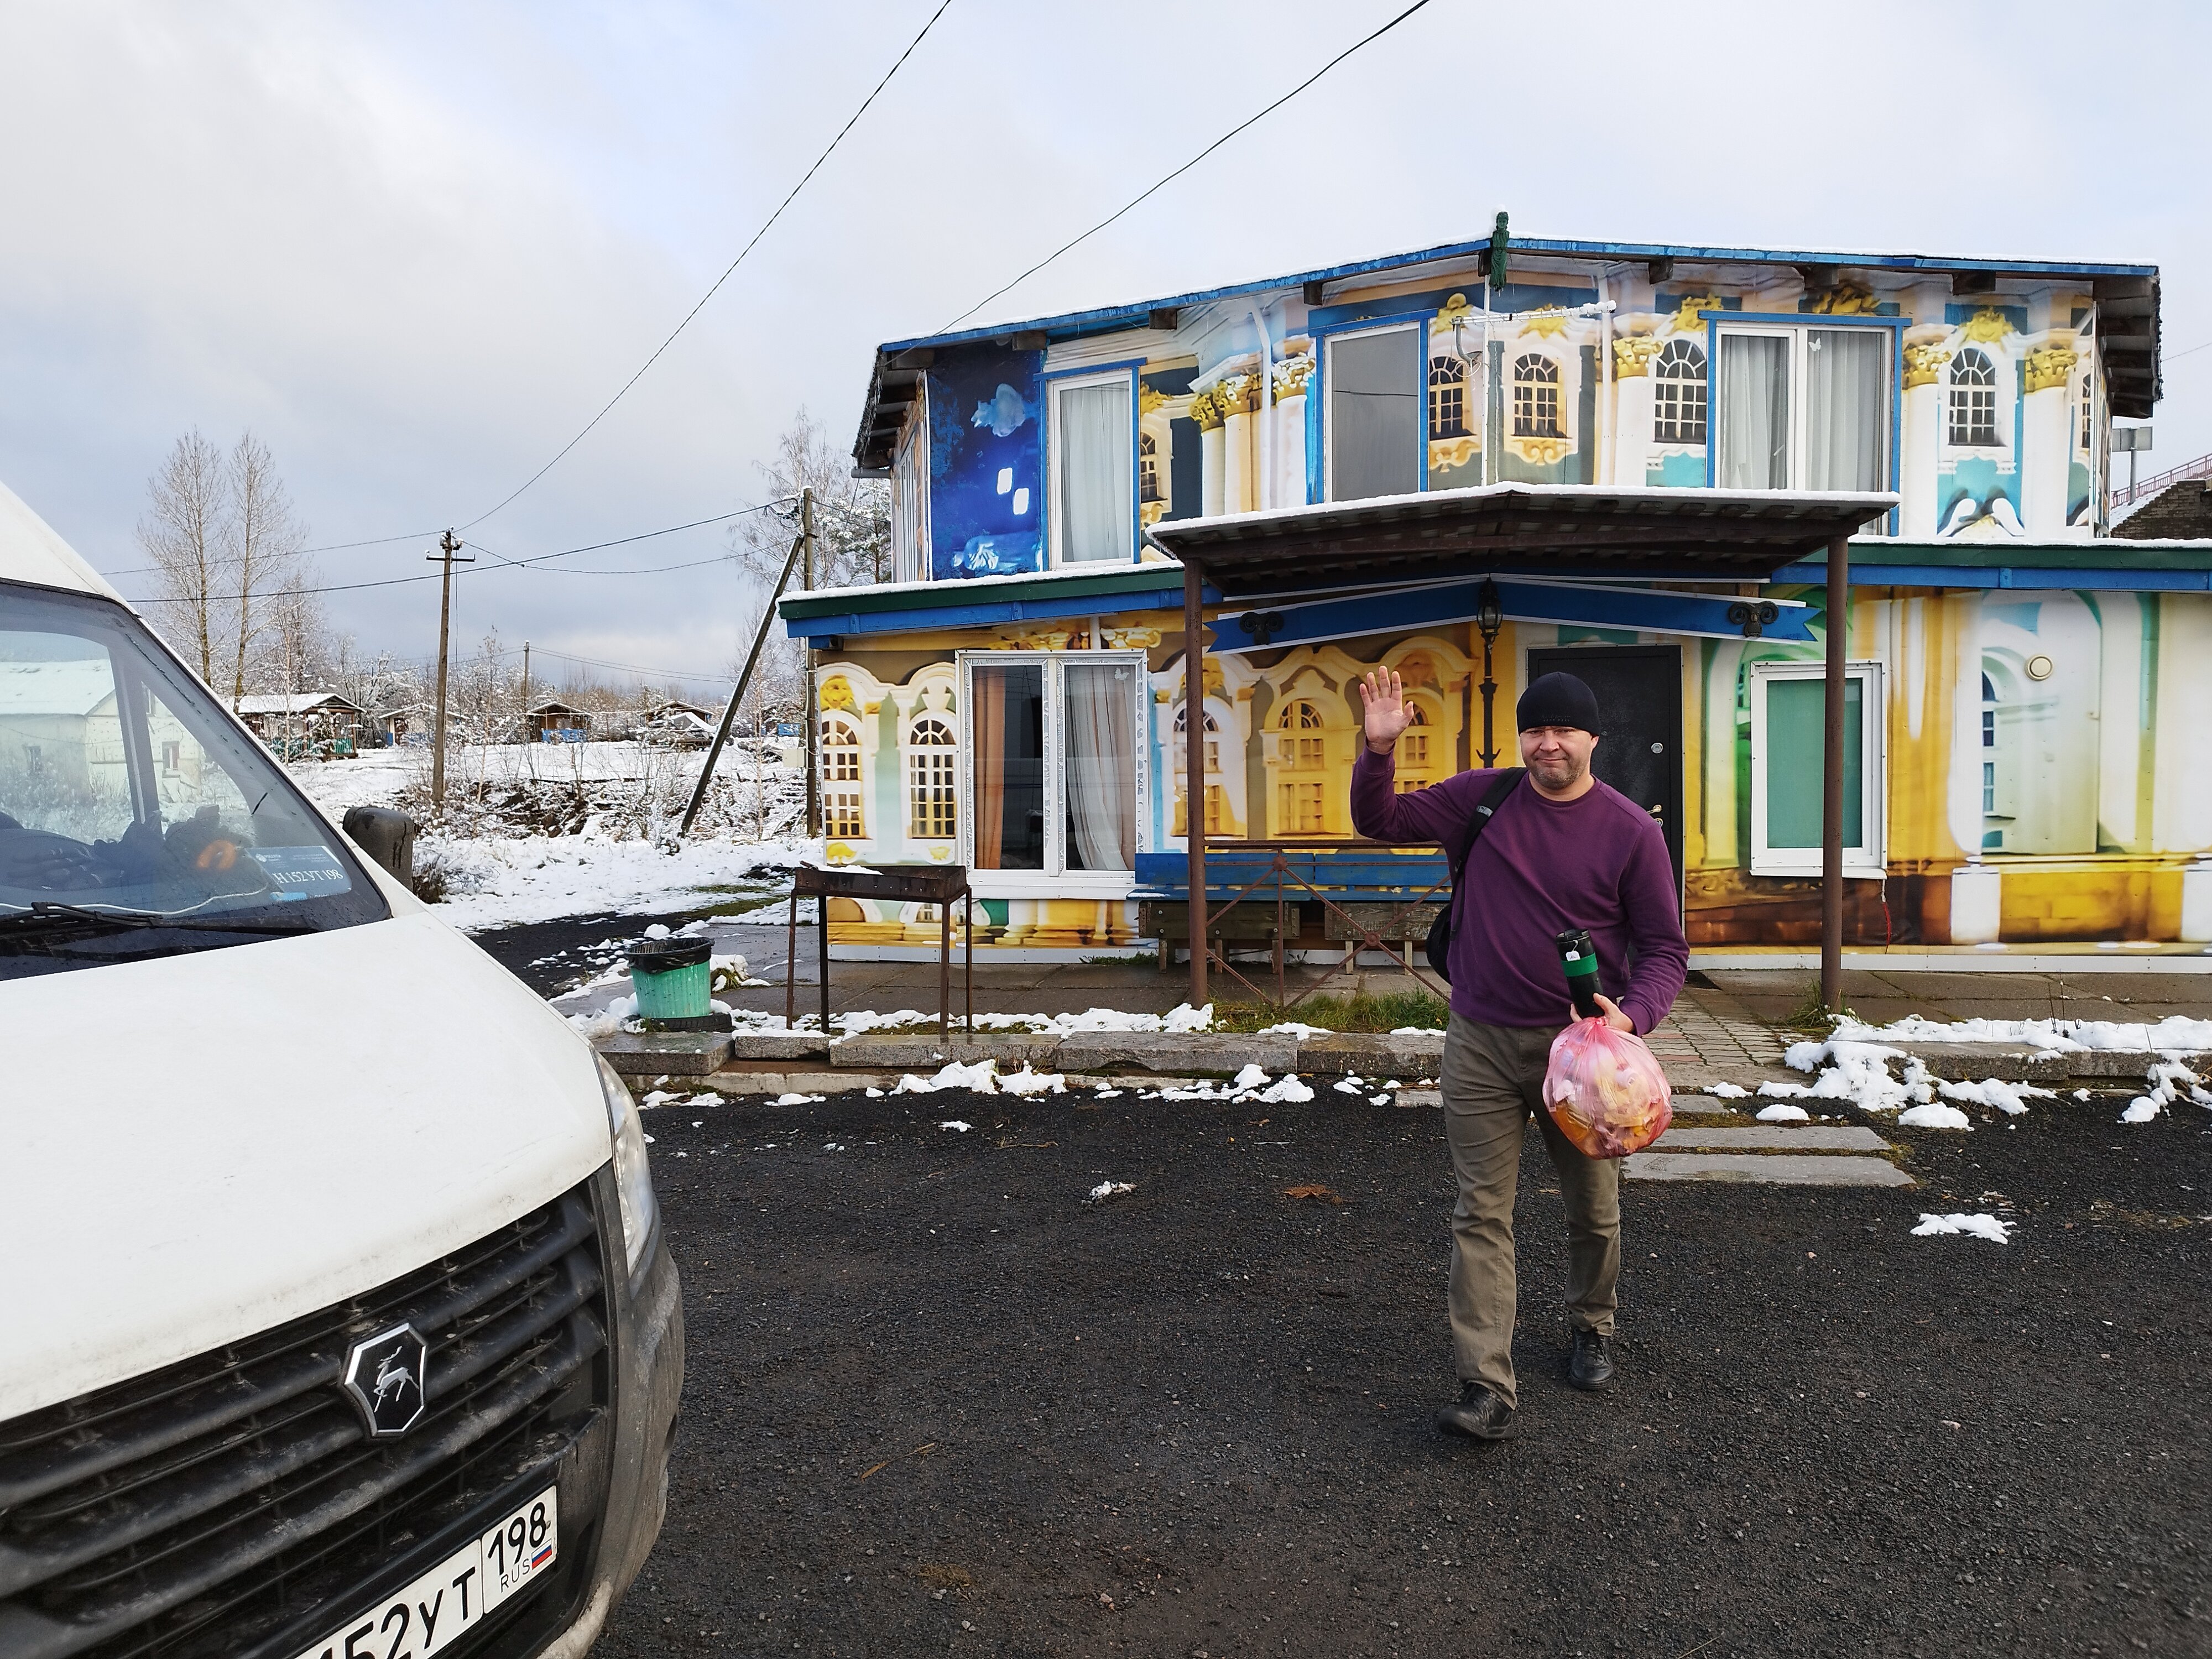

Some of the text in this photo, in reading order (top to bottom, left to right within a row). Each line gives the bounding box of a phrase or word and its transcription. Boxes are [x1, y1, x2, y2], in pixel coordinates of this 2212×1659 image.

[285, 872, 309, 883] 152
[322, 869, 343, 880] 198
[320, 1501, 546, 1659] 52УТ 198
[500, 1558, 531, 1593] RUS
